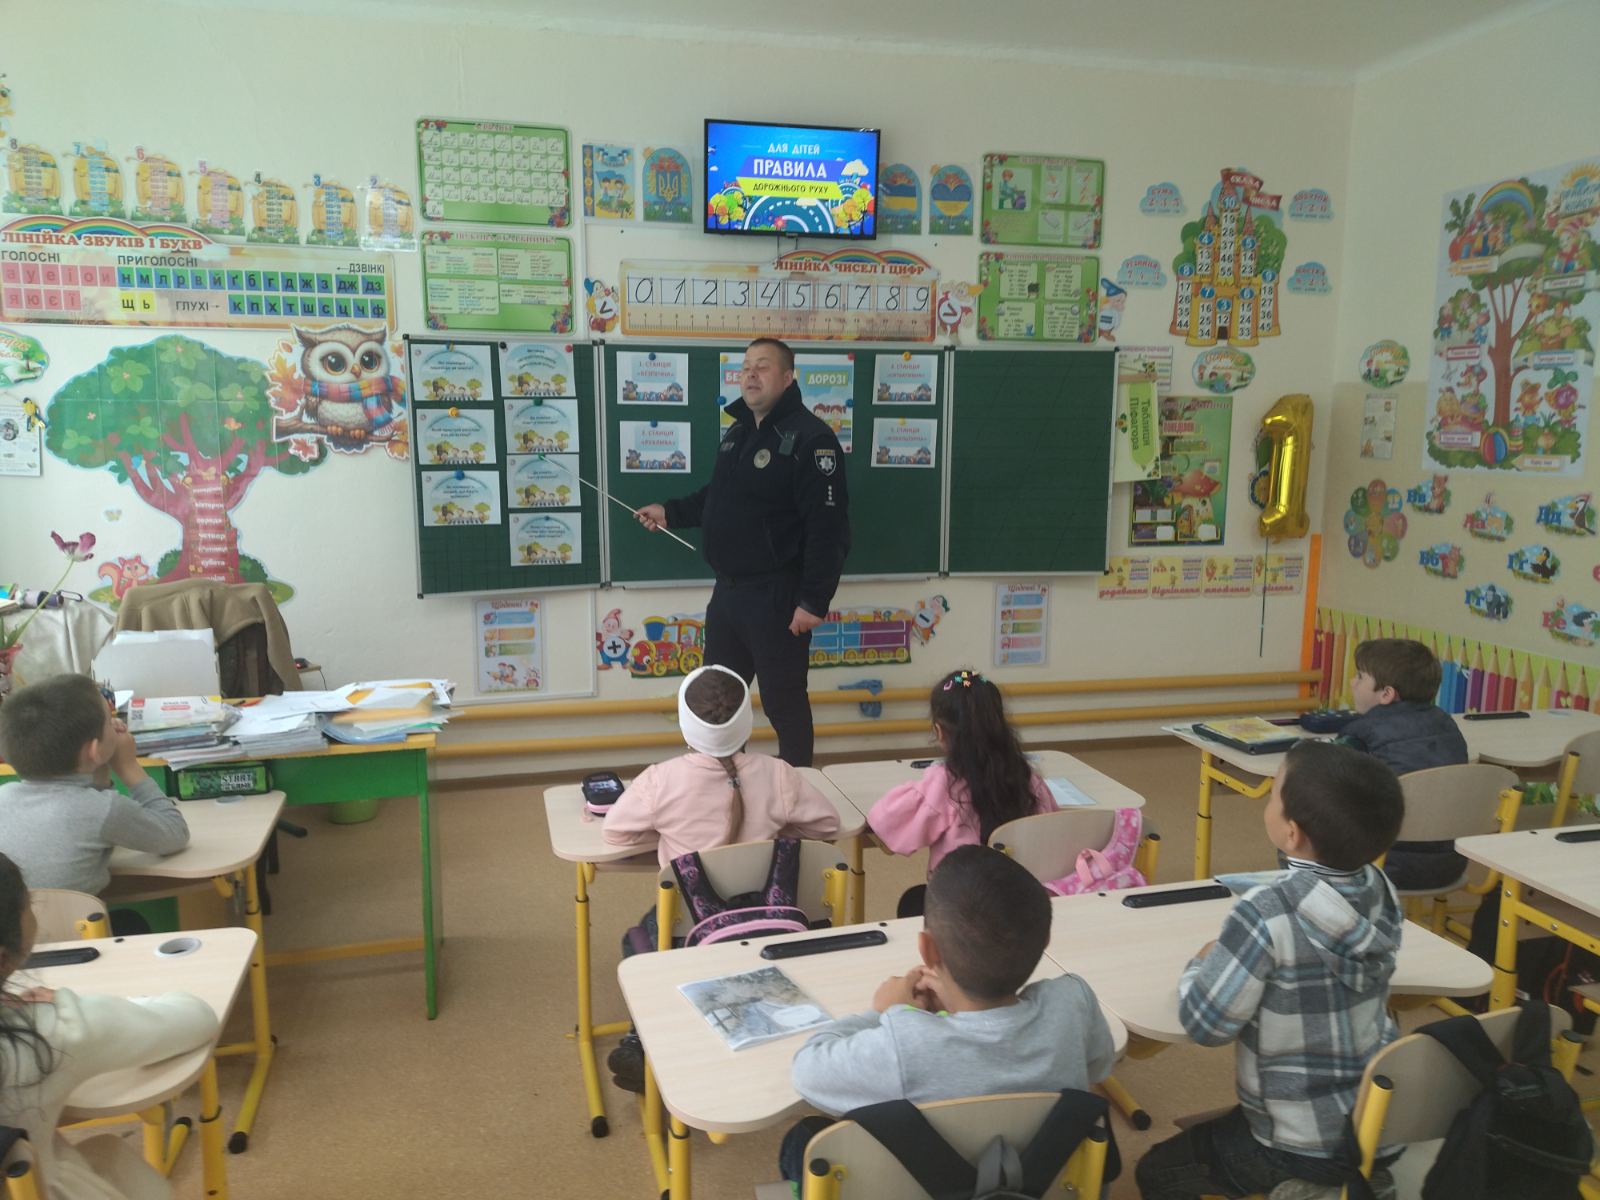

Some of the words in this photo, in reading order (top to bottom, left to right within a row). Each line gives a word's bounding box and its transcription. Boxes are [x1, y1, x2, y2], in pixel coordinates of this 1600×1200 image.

[10, 138, 18, 150] 8
[74, 143, 81, 155] 7
[768, 143, 789, 154] ДЛЯ
[792, 143, 820, 155] ДІТЕЙ
[137, 148, 144, 160] 6
[199, 160, 207, 173] 5
[753, 158, 827, 178] ПРАВИЛА
[255, 172, 262, 184] 4
[314, 174, 321, 186] 3
[371, 176, 378, 188] 2
[753, 183, 806, 193] ДОРОЖНЬОГО
[809, 184, 829, 194] РУХУ
[1224, 197, 1236, 208] 10
[1224, 214, 1235, 223] 19
[2, 229, 79, 246] ЛІНІЙКА
[83, 234, 145, 248] ЗВУКІВ
[150, 237, 155, 248] І
[160, 238, 203, 250] БУКВ
[1202, 234, 1209, 244] 4
[1, 250, 60, 263] ГОЛОСНІ
[118, 255, 198, 267] ПРИГОЛОСНІ
[349, 263, 385, 274] ДЗВІНКІ
[774, 256, 830, 272] ЛІНІЙКА
[834, 263, 878, 273] ЧИСЕЛ
[881, 264, 886, 273] І
[889, 264, 924, 275] ЦИФР
[1198, 264, 1210, 272] 22
[46, 271, 56, 281] е
[84, 272, 94, 282] о
[122, 272, 132, 282] н
[140, 273, 150, 283] м
[158, 273, 168, 284] л
[177, 274, 186, 289] р
[195, 274, 204, 285] в
[213, 273, 222, 284] й
[248, 274, 257, 287] б
[268, 278, 274, 286] г
[286, 279, 295, 289] д
[302, 279, 313, 289] ж
[321, 279, 329, 289] з
[337, 280, 358, 291] дж
[365, 281, 381, 291] дз
[27, 295, 40, 304] ю
[635, 278, 654, 303] 0
[674, 278, 686, 304] 1
[702, 280, 718, 305] 2
[732, 281, 749, 306] 3
[760, 282, 781, 307] 4
[792, 283, 811, 308] 5
[825, 284, 841, 309] 6
[855, 285, 871, 310] 7
[886, 286, 901, 311] 8
[913, 287, 929, 311] 9
[176, 300, 209, 311] ГЛУХІ
[233, 302, 241, 311] к
[251, 302, 259, 310] п
[269, 302, 277, 312] х
[286, 303, 294, 312] т
[303, 303, 314, 313] ш
[322, 304, 330, 314] с
[340, 304, 348, 316] ц
[357, 305, 365, 314] ч
[373, 304, 384, 317] ф
[808, 374, 846, 384] ДОРОЗІ
[1141, 399, 1151, 447] Таблиця
[1407, 488, 1426, 503] Вв
[1464, 512, 1486, 529] Аа
[1419, 551, 1439, 566] Бб
